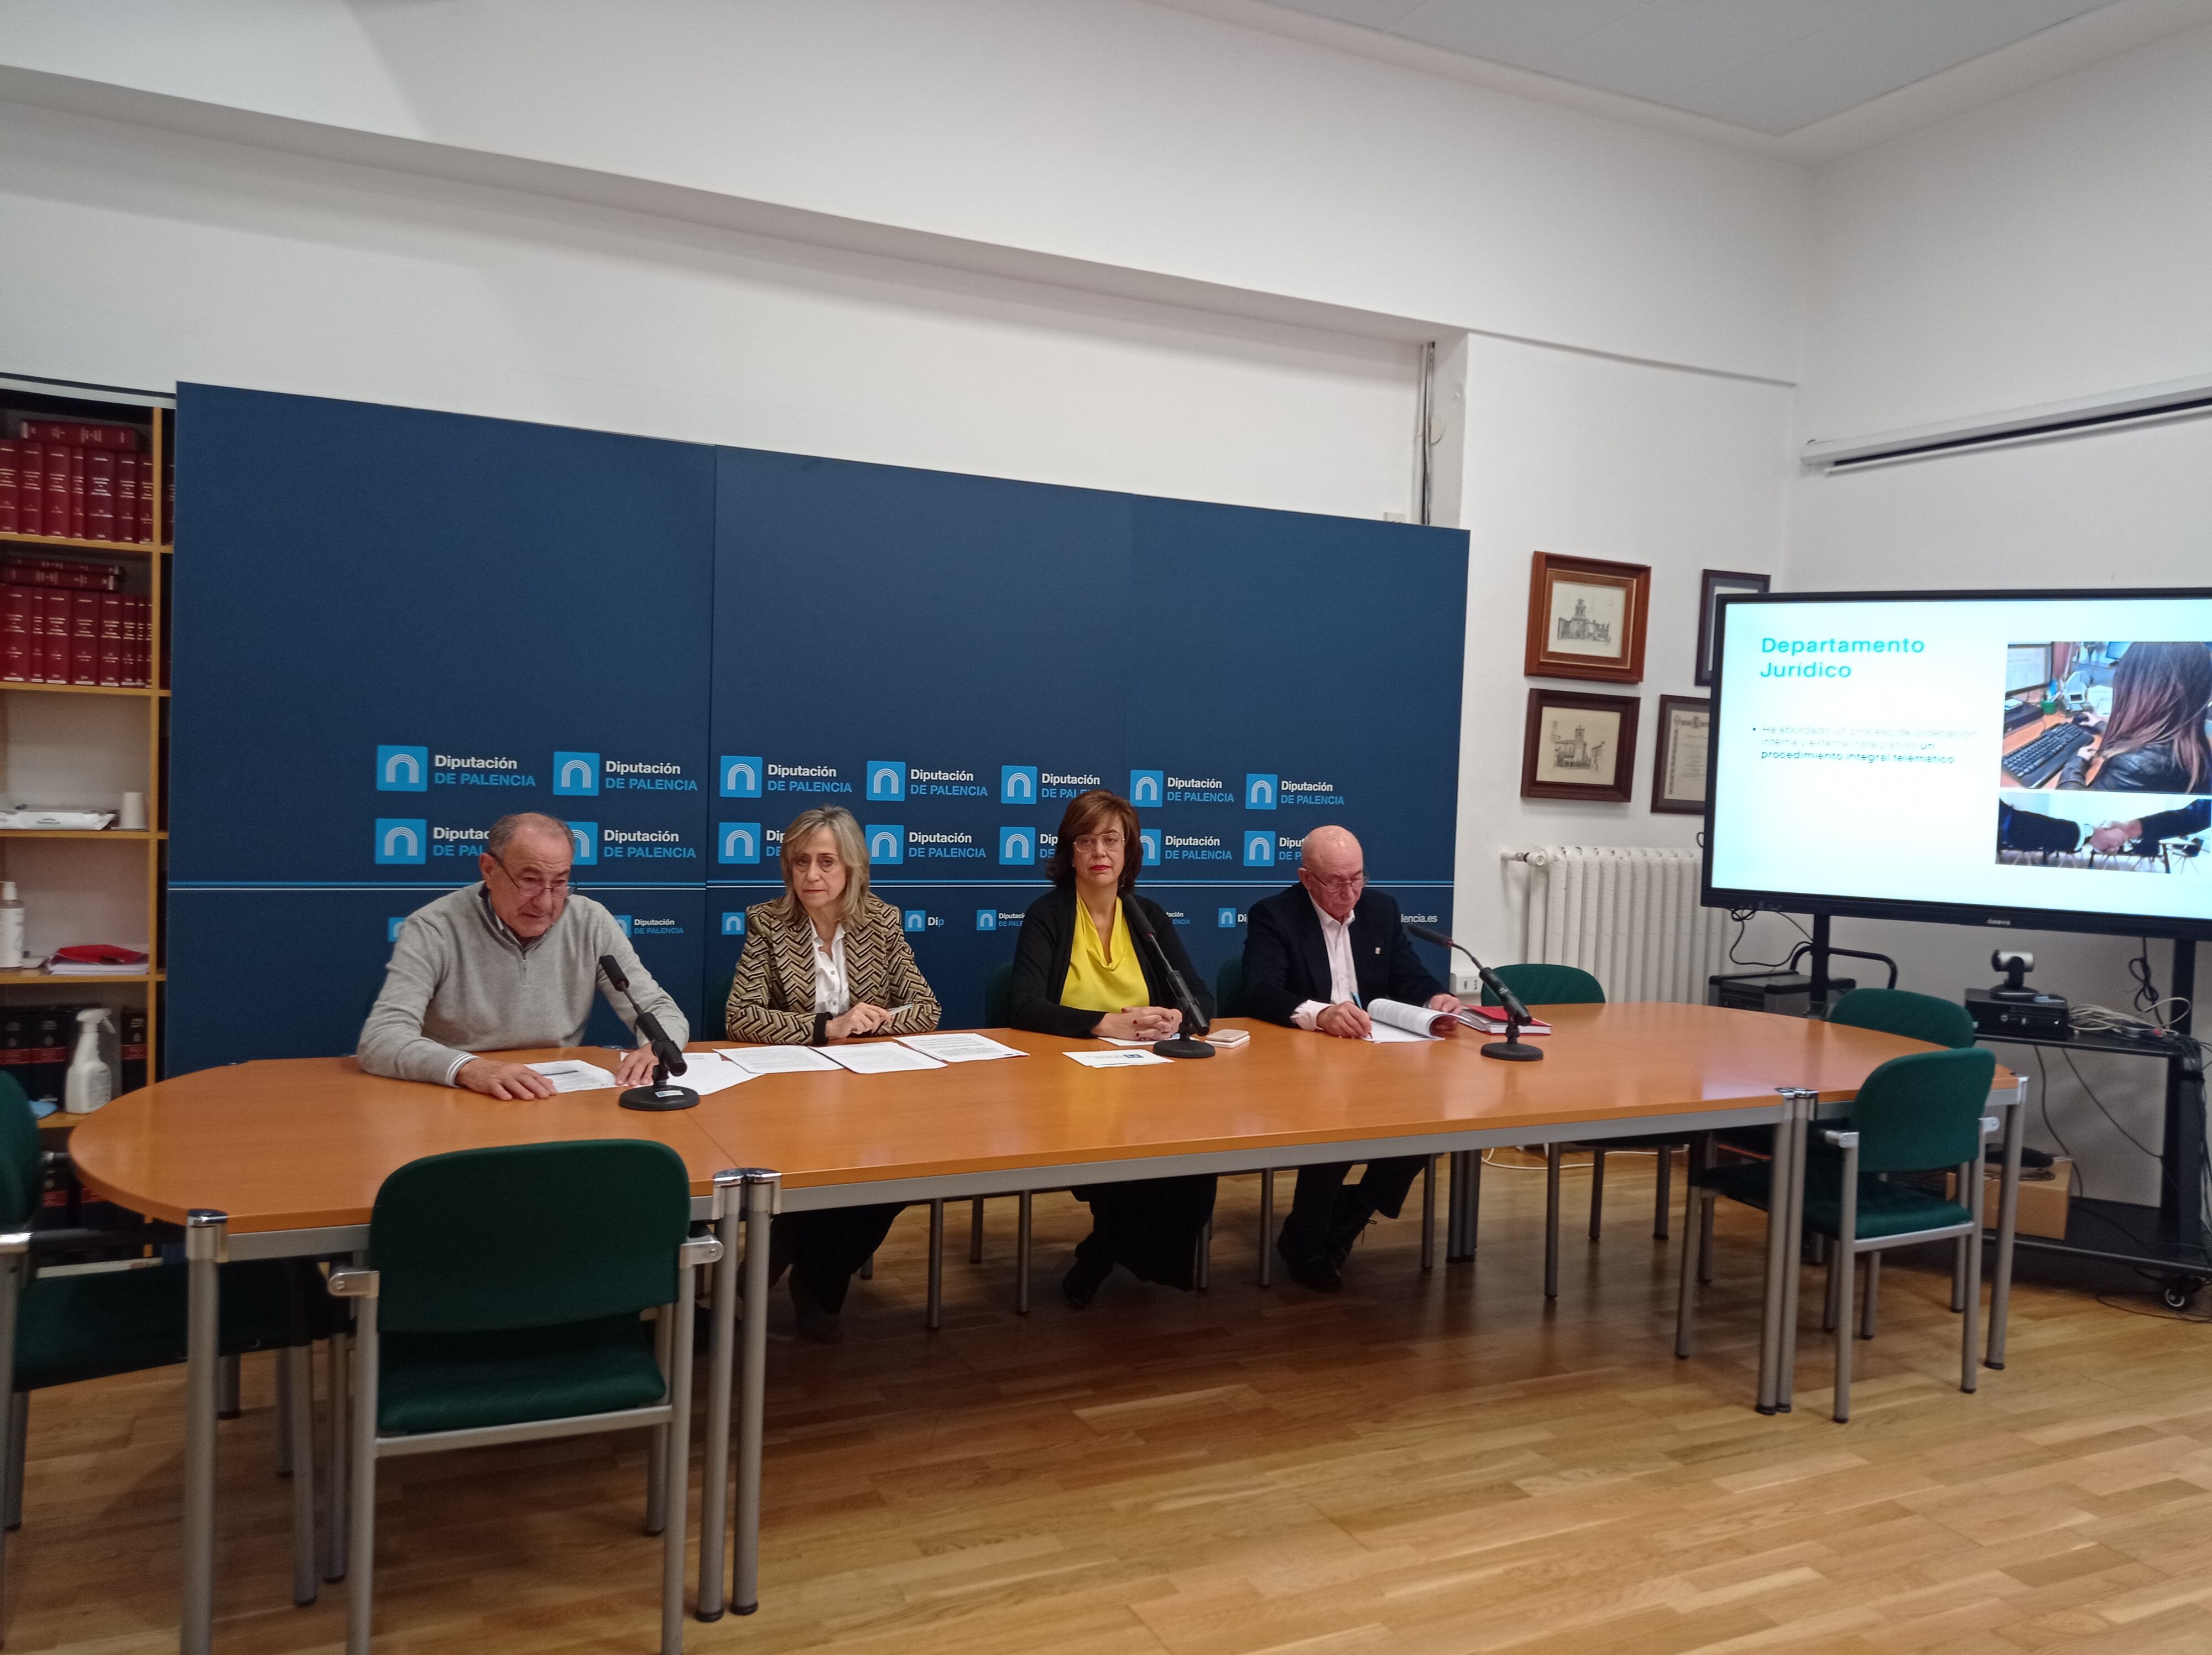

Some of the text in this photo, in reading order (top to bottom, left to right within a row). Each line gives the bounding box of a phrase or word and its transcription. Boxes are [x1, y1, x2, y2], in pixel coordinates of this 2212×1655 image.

[1762, 638, 1926, 656] Departamento
[1760, 662, 1851, 678] Jurídico
[435, 754, 517, 770] Diputación
[1761, 751, 1843, 759] procedimiento
[1846, 753, 1890, 763] integral
[606, 761, 681, 775] Diputación
[768, 764, 837, 778] Diputación
[435, 773, 536, 787] DE PALENCIA
[911, 769, 974, 782] Diputación
[1042, 773, 1100, 786] Diputación
[606, 778, 698, 791] DE PALENCIA
[768, 780, 853, 793] DE PALENCIA
[1167, 777, 1222, 789] Diputación
[1281, 780, 1333, 793] Diputación
[911, 784, 988, 797] DE PALENCIA
[1042, 788, 1057, 798] DE
[1167, 792, 1235, 803] DE PALENCIA
[1281, 795, 1344, 805] DE PALENCIA
[433, 827, 490, 841] Diputac
[604, 830, 679, 844] Diputación
[909, 832, 972, 845] Diputación
[1165, 836, 1220, 848] Diputación
[433, 845, 454, 856] DE
[604, 846, 696, 858] DE PALENCIA
[909, 847, 987, 858] DE PALENCIA
[1165, 850, 1233, 860] DE PALENCIA
[1279, 851, 1292, 860] DE
[927, 917, 945, 928] Dip
[1238, 914, 1248, 924] Di
[1400, 913, 1438, 923] lencia.es
